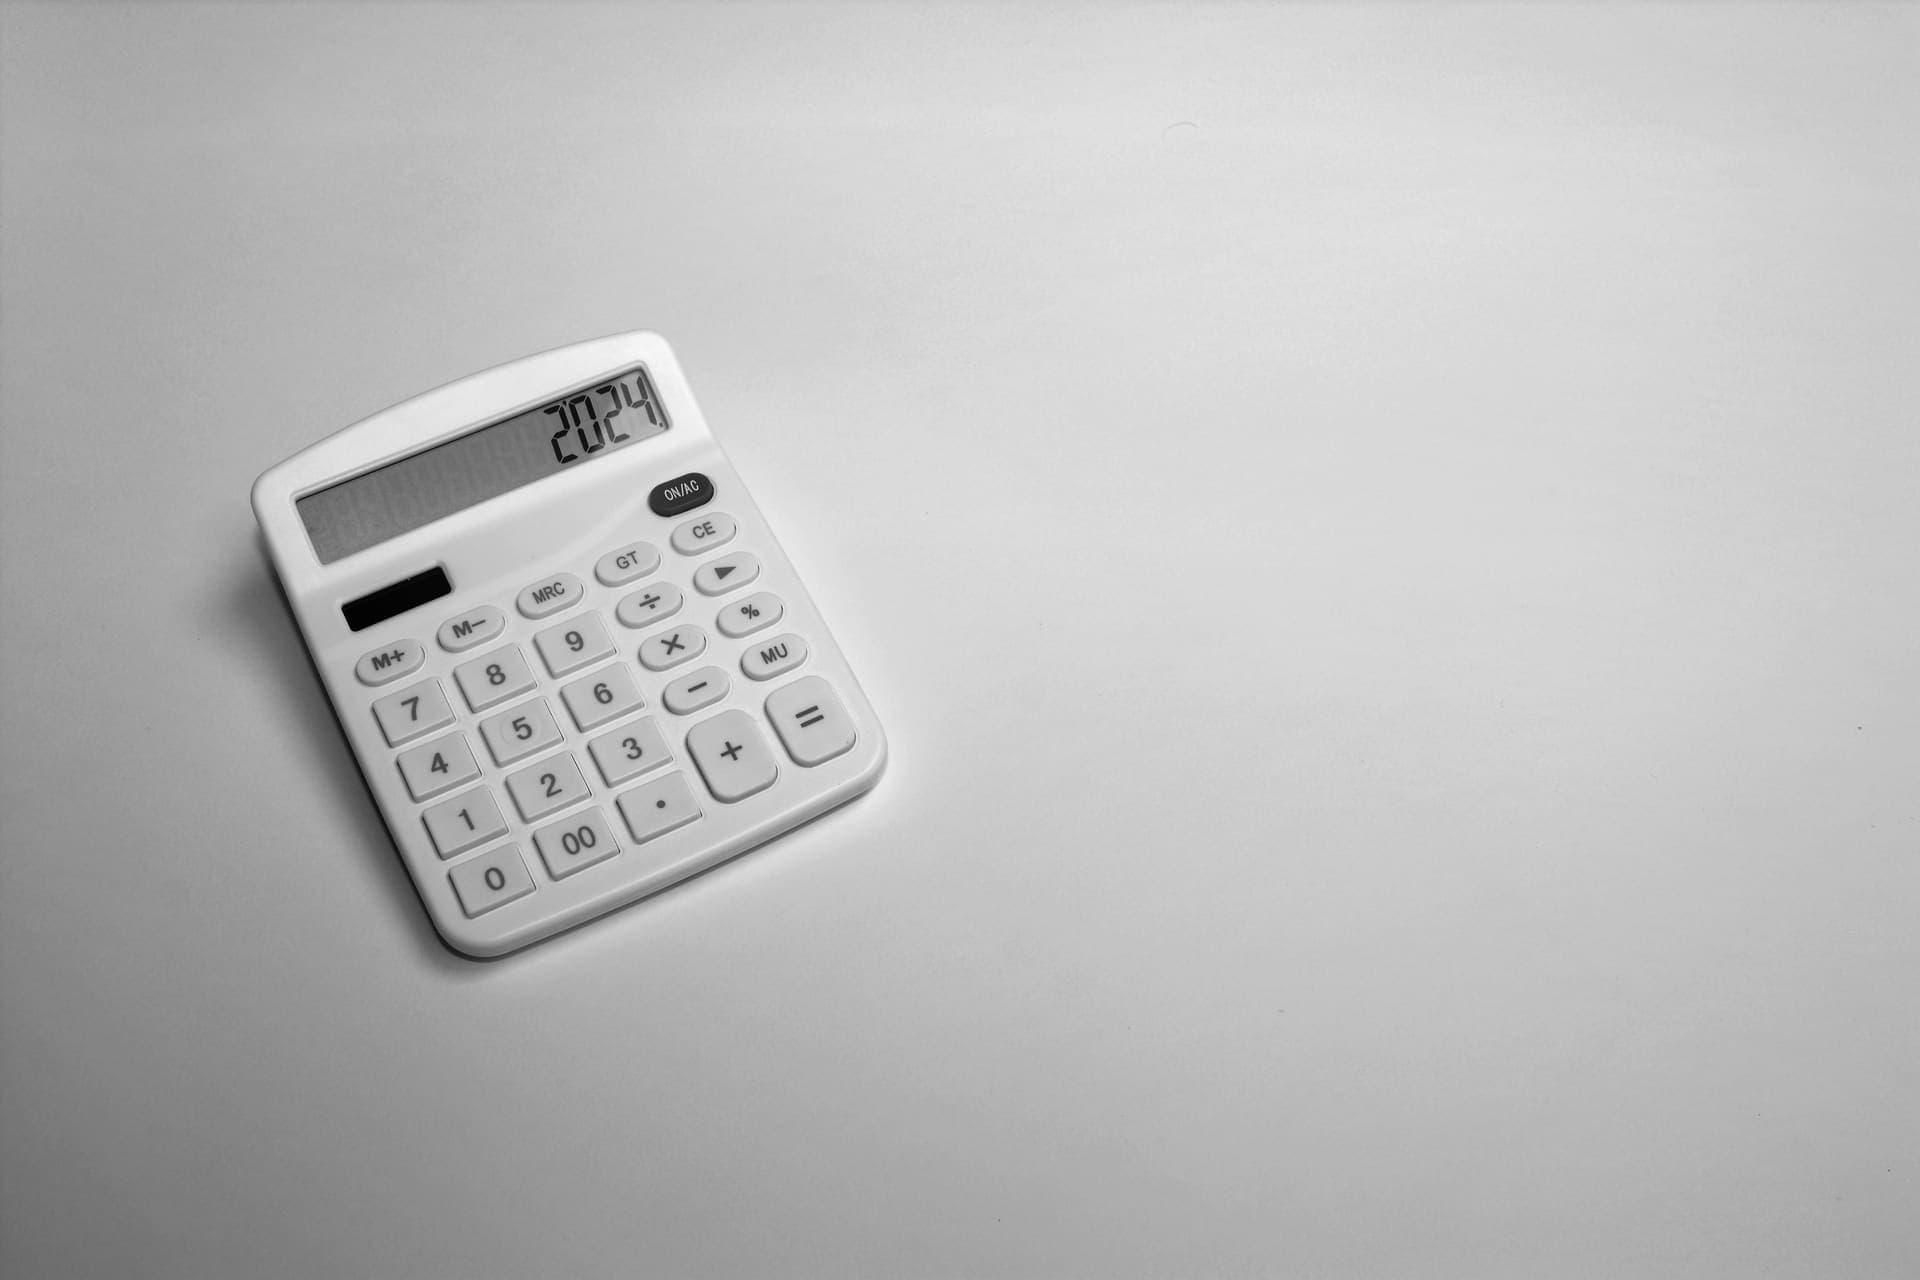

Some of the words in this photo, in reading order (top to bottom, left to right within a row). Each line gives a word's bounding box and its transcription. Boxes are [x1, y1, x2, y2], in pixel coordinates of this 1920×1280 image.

[664, 478, 700, 502] ON/AC
[692, 521, 716, 539] CE
[615, 550, 639, 570] GT
[531, 581, 566, 605] MRC
[740, 603, 761, 620] %
[564, 630, 585, 652] 9
[371, 649, 405, 671] M+
[760, 642, 789, 665] MU
[485, 663, 507, 686] 8
[593, 682, 614, 705] 6
[400, 695, 421, 722] 7
[511, 716, 534, 741] 5
[621, 737, 643, 761] 3
[429, 752, 449, 775] 4
[540, 773, 563, 799] 2
[457, 808, 476, 831] 1
[561, 825, 597, 856] 00
[484, 866, 506, 892] 0
